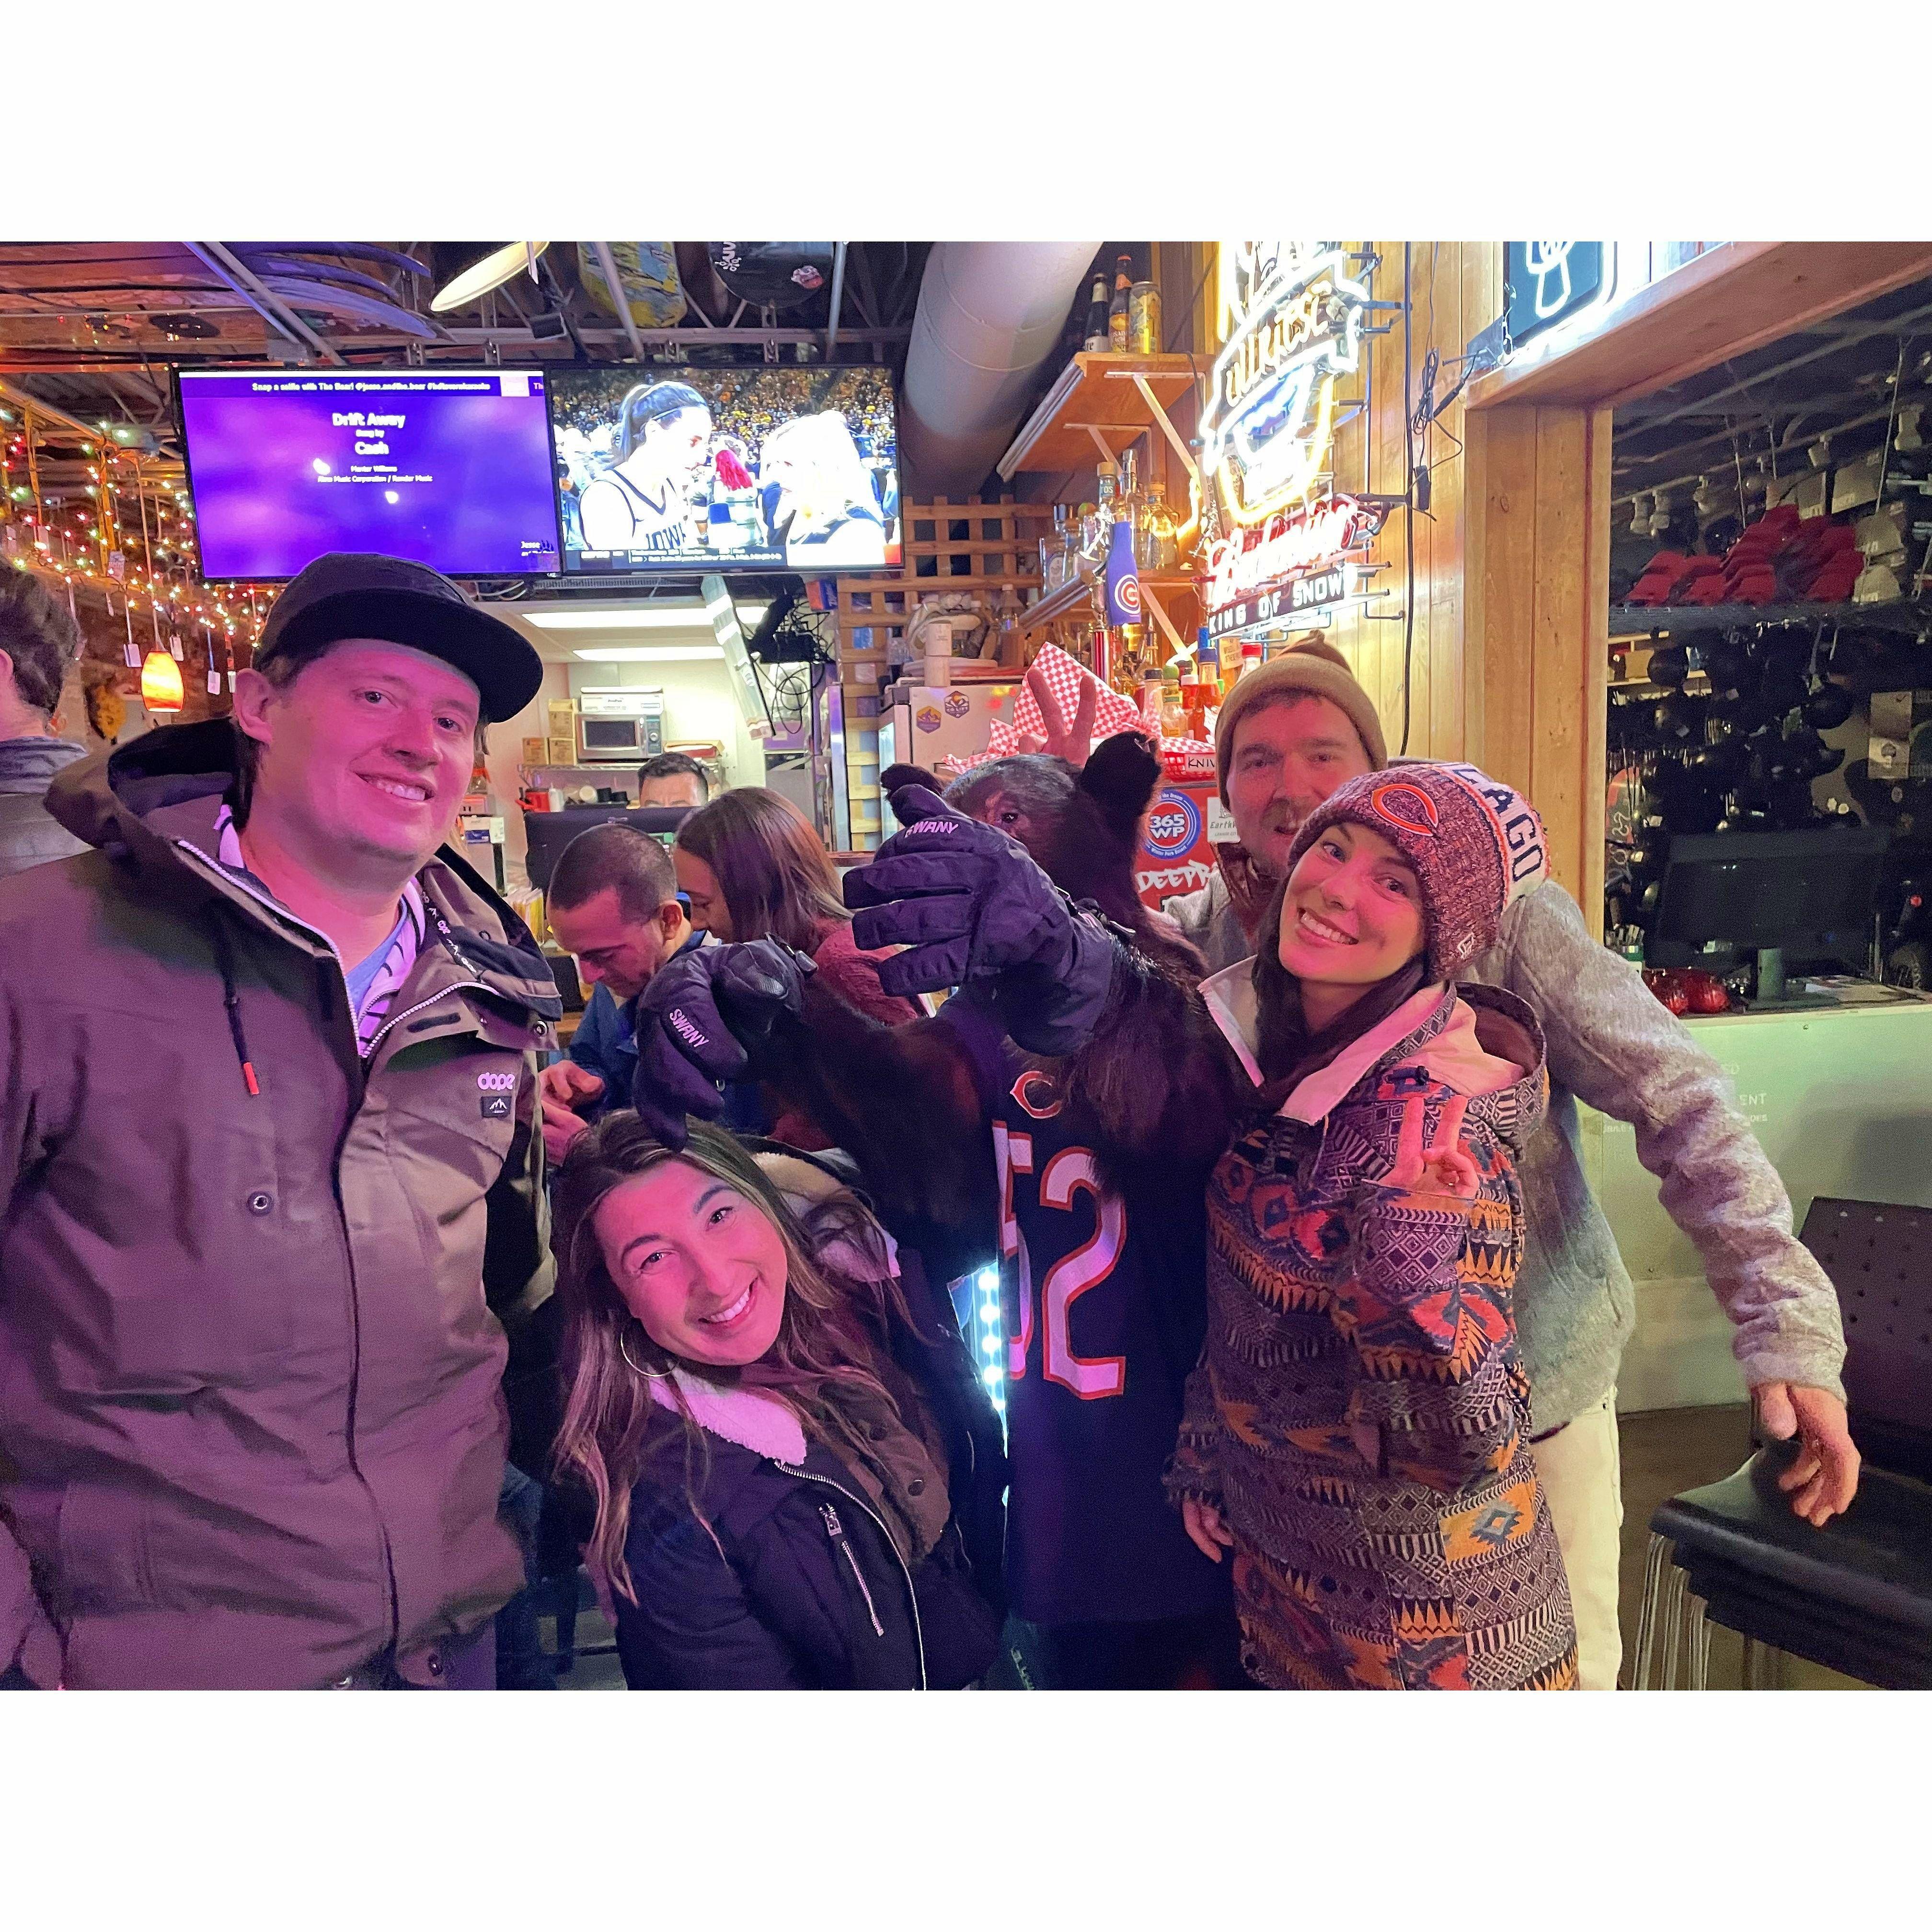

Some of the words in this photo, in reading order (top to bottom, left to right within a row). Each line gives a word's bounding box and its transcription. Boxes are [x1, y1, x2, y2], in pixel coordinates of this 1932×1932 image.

[252, 382, 272, 392] Snap
[318, 382, 334, 391] The
[332, 412, 366, 426] Drift
[367, 412, 406, 428] Away
[1208, 604, 1247, 635] KING
[1258, 591, 1281, 619] OF
[1293, 571, 1344, 608] SNOW
[1150, 813, 1185, 828] 365
[1150, 826, 1185, 839] WP
[669, 1008, 709, 1047] SWANY
[477, 1071, 516, 1092] dope
